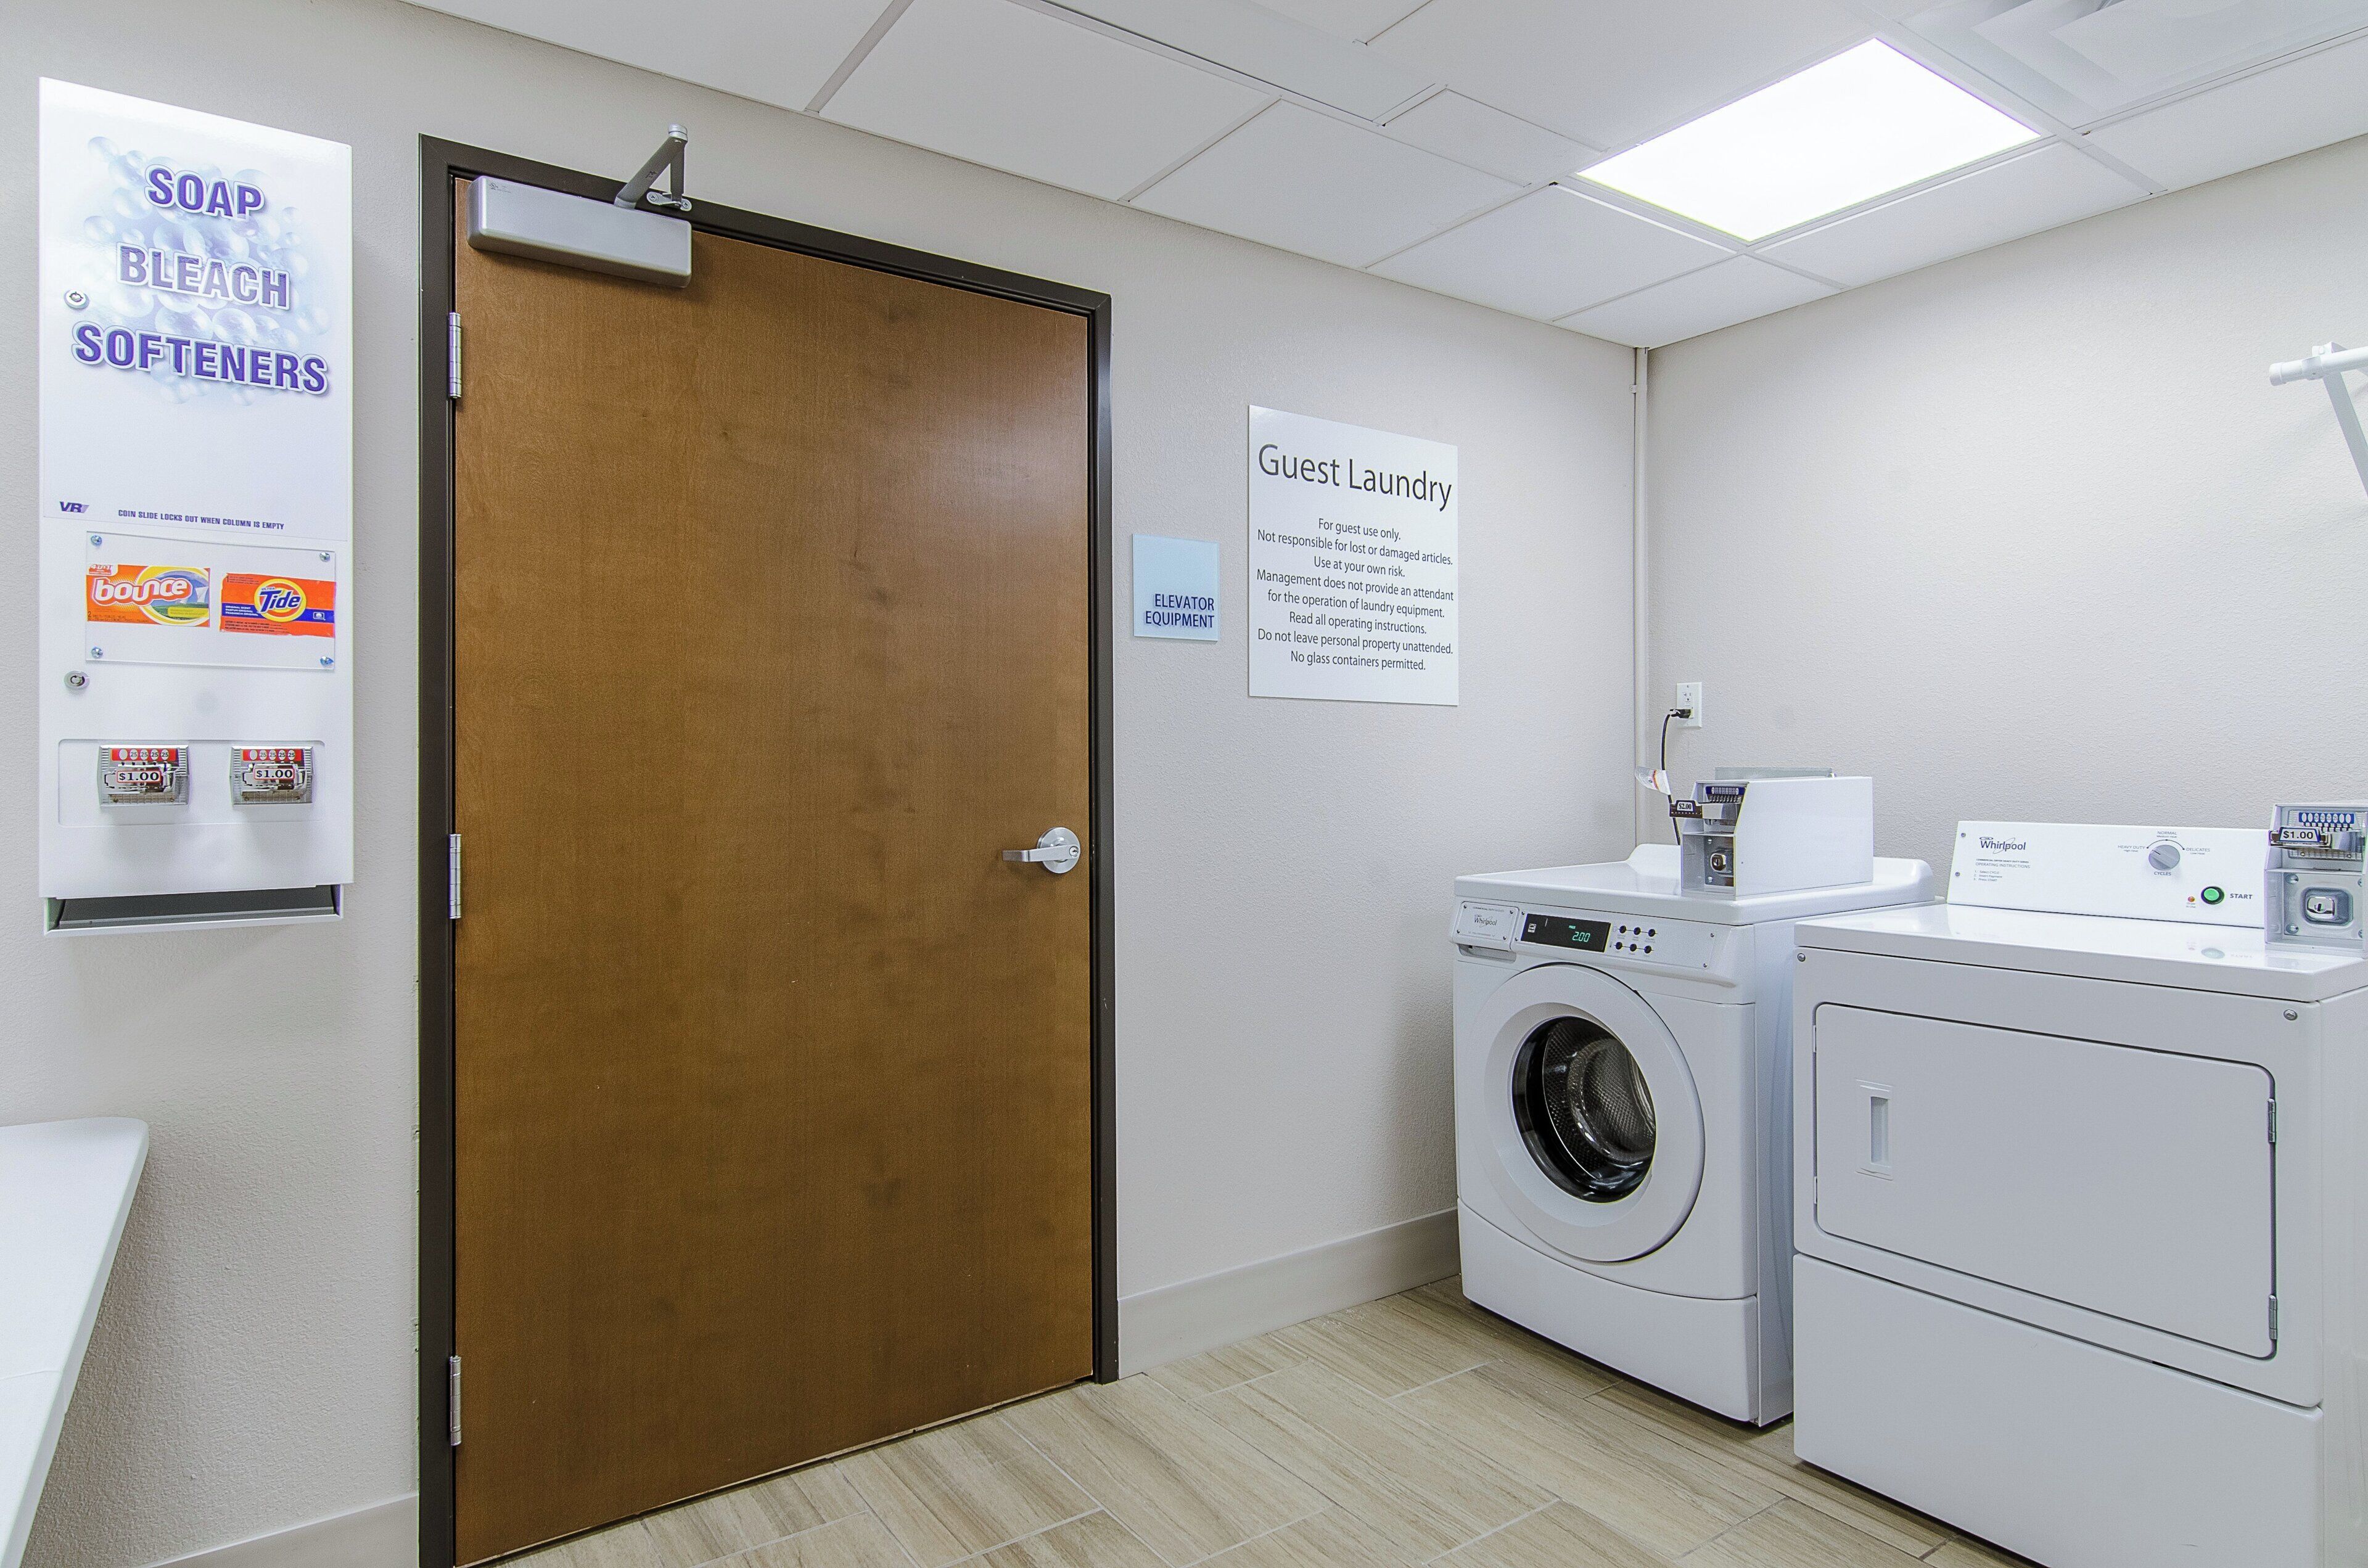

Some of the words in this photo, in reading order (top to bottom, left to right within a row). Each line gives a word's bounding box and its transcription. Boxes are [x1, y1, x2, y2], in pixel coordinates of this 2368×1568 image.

[147, 167, 262, 218] SOAP
[119, 245, 288, 308] BLEACH
[75, 324, 326, 392] SOFTENERS
[1259, 443, 1340, 486] Guest
[1349, 458, 1452, 512] Laundry
[118, 509, 136, 517] COIN
[138, 511, 158, 519] SLIDE
[160, 513, 183, 522] LOCKS
[200, 516, 220, 525] WHEN
[223, 518, 251, 527] COLUMN
[262, 522, 284, 530] EMPTY
[1318, 518, 1333, 530] For
[1336, 523, 1361, 535] guest
[1363, 527, 1378, 536] use
[1380, 528, 1401, 542] only.
[1257, 529, 1276, 543] Not
[1278, 534, 1333, 549] responsible
[1335, 538, 1348, 551] for
[1350, 541, 1366, 554] lost
[1368, 546, 1378, 555] or
[1379, 545, 1420, 562] damaged
[1421, 552, 1453, 565] articles.
[1314, 556, 1331, 569] Use
[1333, 560, 1342, 570] at
[1344, 562, 1365, 573] your
[1367, 564, 1386, 575] own
[1388, 565, 1405, 578] risk.
[94, 578, 188, 602] bounce
[1257, 569, 1322, 586] Management
[1323, 576, 1346, 589] does
[1348, 581, 1363, 591] not
[1365, 583, 1399, 594] provide
[1400, 587, 1411, 596] an
[1413, 588, 1454, 601] attendant
[260, 589, 302, 613] Tide
[1155, 593, 1214, 611] ELEVATOR
[1268, 589, 1281, 602] for
[1284, 591, 1300, 604] the
[1302, 596, 1347, 609] operation
[1349, 598, 1360, 609] of
[1361, 598, 1395, 615] laundry
[1396, 604, 1445, 618] equipment.
[1145, 610, 1215, 628] EQUIPMENT
[1289, 611, 1313, 624] Read
[1315, 614, 1326, 625] all
[1328, 617, 1373, 632] operating
[1375, 619, 1427, 634] instructions.
[1258, 628, 1272, 641] Do
[1275, 631, 1291, 642] not
[1294, 630, 1318, 644] leave
[1321, 635, 1360, 647] personal
[1362, 639, 1400, 653] property
[1402, 642, 1453, 654] unattended.
[1291, 651, 1304, 662] No
[1307, 651, 1330, 666] glass
[1332, 655, 1379, 667] containers
[1381, 659, 1426, 670] permitted.
[118, 772, 160, 781] $1.00
[256, 769, 293, 778] $1.00
[1980, 840, 2027, 852] Whirlpool
[2283, 831, 2314, 839] $1.00
[1572, 931, 1591, 943] 2.00
